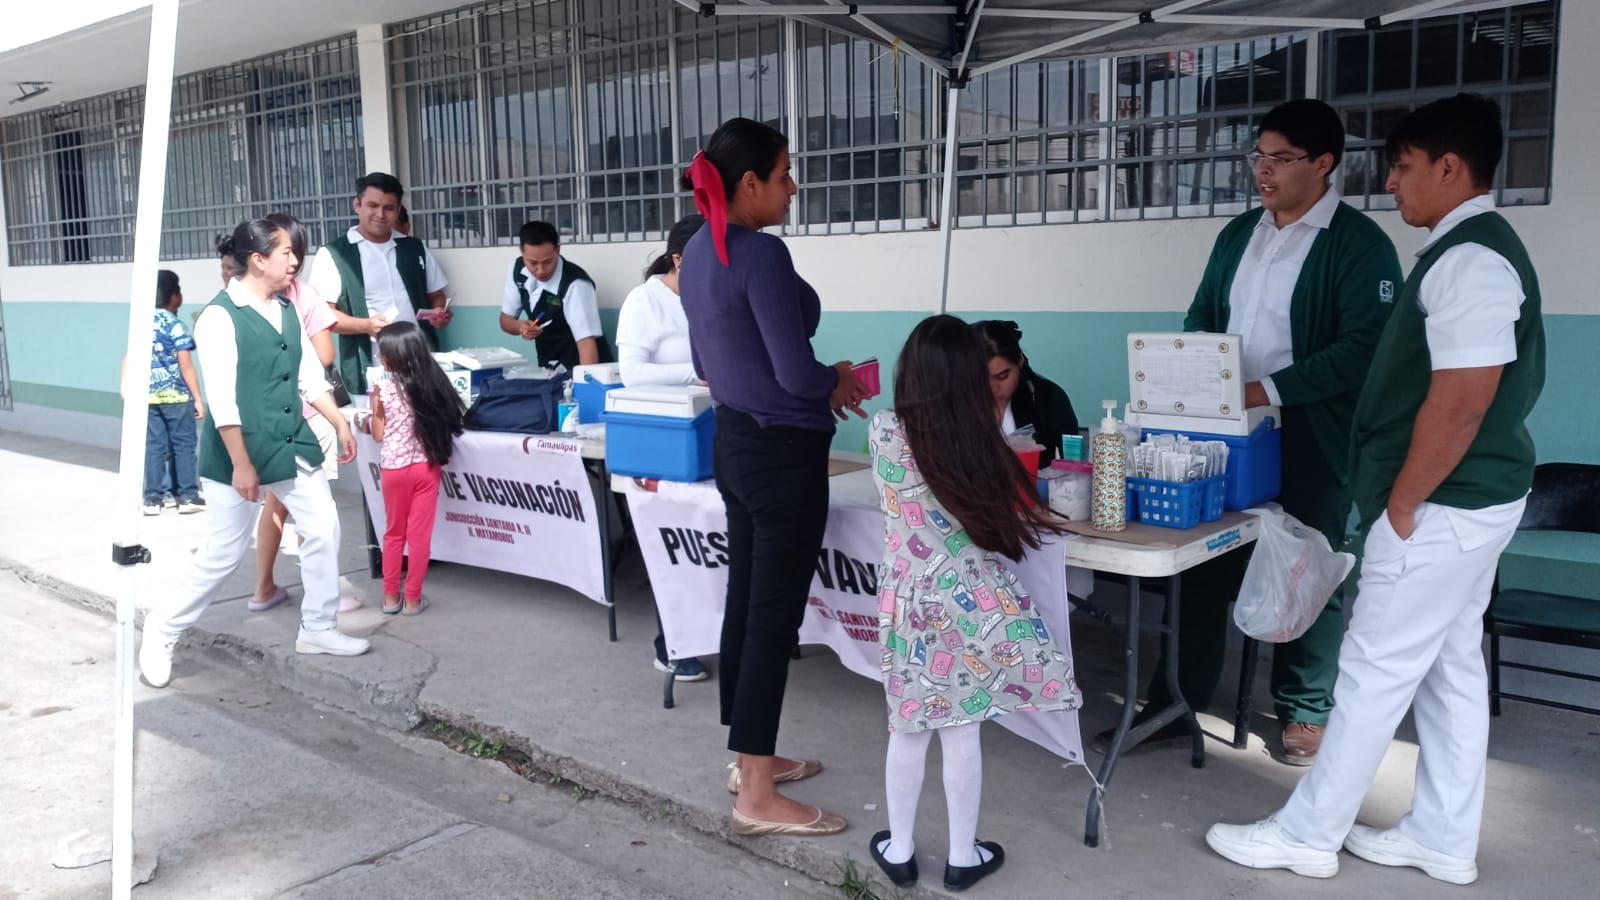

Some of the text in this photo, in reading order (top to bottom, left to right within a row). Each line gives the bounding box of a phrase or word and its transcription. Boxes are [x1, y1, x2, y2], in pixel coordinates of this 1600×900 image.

[537, 439, 577, 453] Tamaulipas
[441, 470, 467, 501] DE
[463, 472, 586, 523] VACUNACIÓN
[485, 517, 516, 533] SANITARIA
[475, 527, 515, 544] MATAMOROS
[659, 527, 730, 568] PUES
